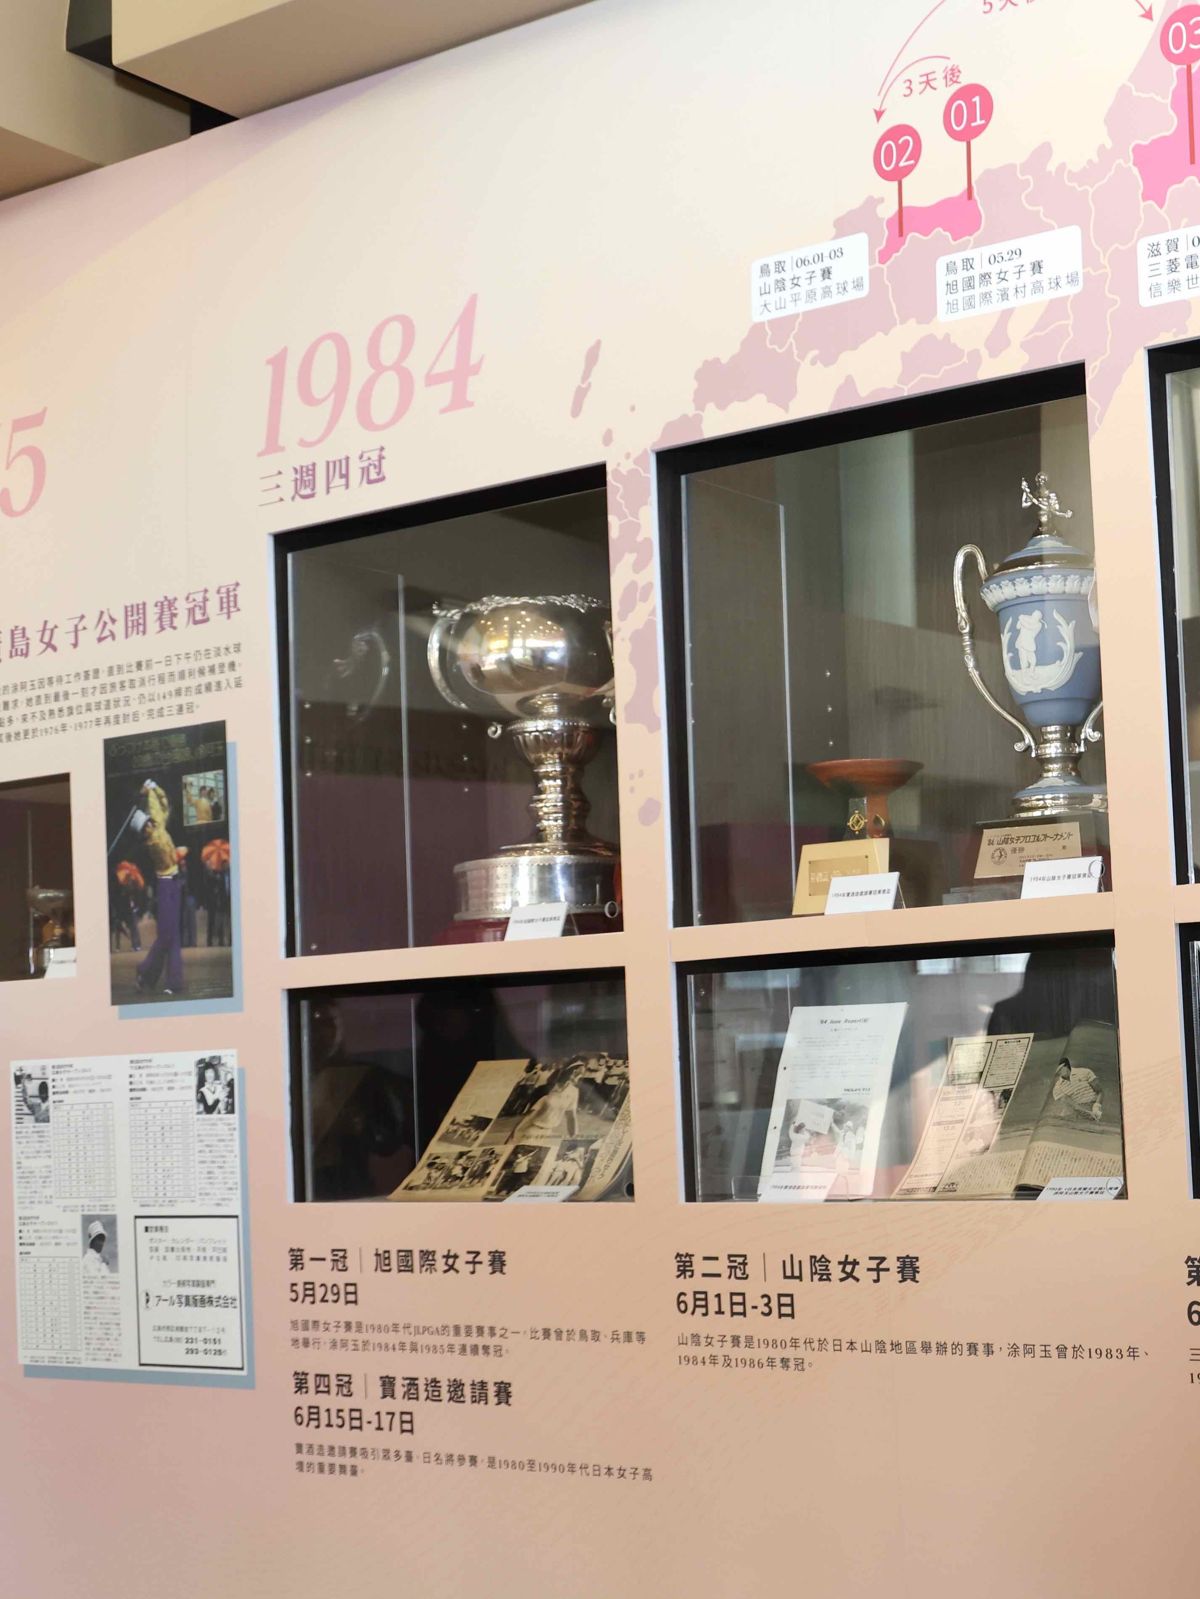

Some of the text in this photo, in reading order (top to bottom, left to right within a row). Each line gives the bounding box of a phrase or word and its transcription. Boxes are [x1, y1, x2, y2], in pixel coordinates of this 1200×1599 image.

[903, 64, 962, 98] 3天後
[949, 96, 986, 132] 01
[880, 135, 914, 171] 02
[945, 247, 1023, 276] 鳥取 05.29
[1146, 238, 1180, 258] 滋賀
[758, 260, 787, 279] 鳥取
[758, 265, 833, 296] 山陰女子賽
[945, 260, 1044, 296] 旭國際女子賽
[759, 276, 864, 315] 大山平原高球場
[945, 272, 1080, 315] 旭國際濱村高球場
[256, 293, 486, 457] 1984
[257, 446, 387, 507] 三週四冠
[0, 581, 242, 664] 島女子公開賽冠軍
[287, 1247, 508, 1276] 第一冠 旭國際女子賽
[674, 1252, 921, 1285] 第二冠 山陰女子賽
[289, 1281, 359, 1306] 5月29日
[676, 1291, 796, 1319] 6月1日-3日
[292, 1371, 513, 1407] 第四冠 寶酒造邀請賽
[293, 1405, 415, 1435] 6月15日-17日
